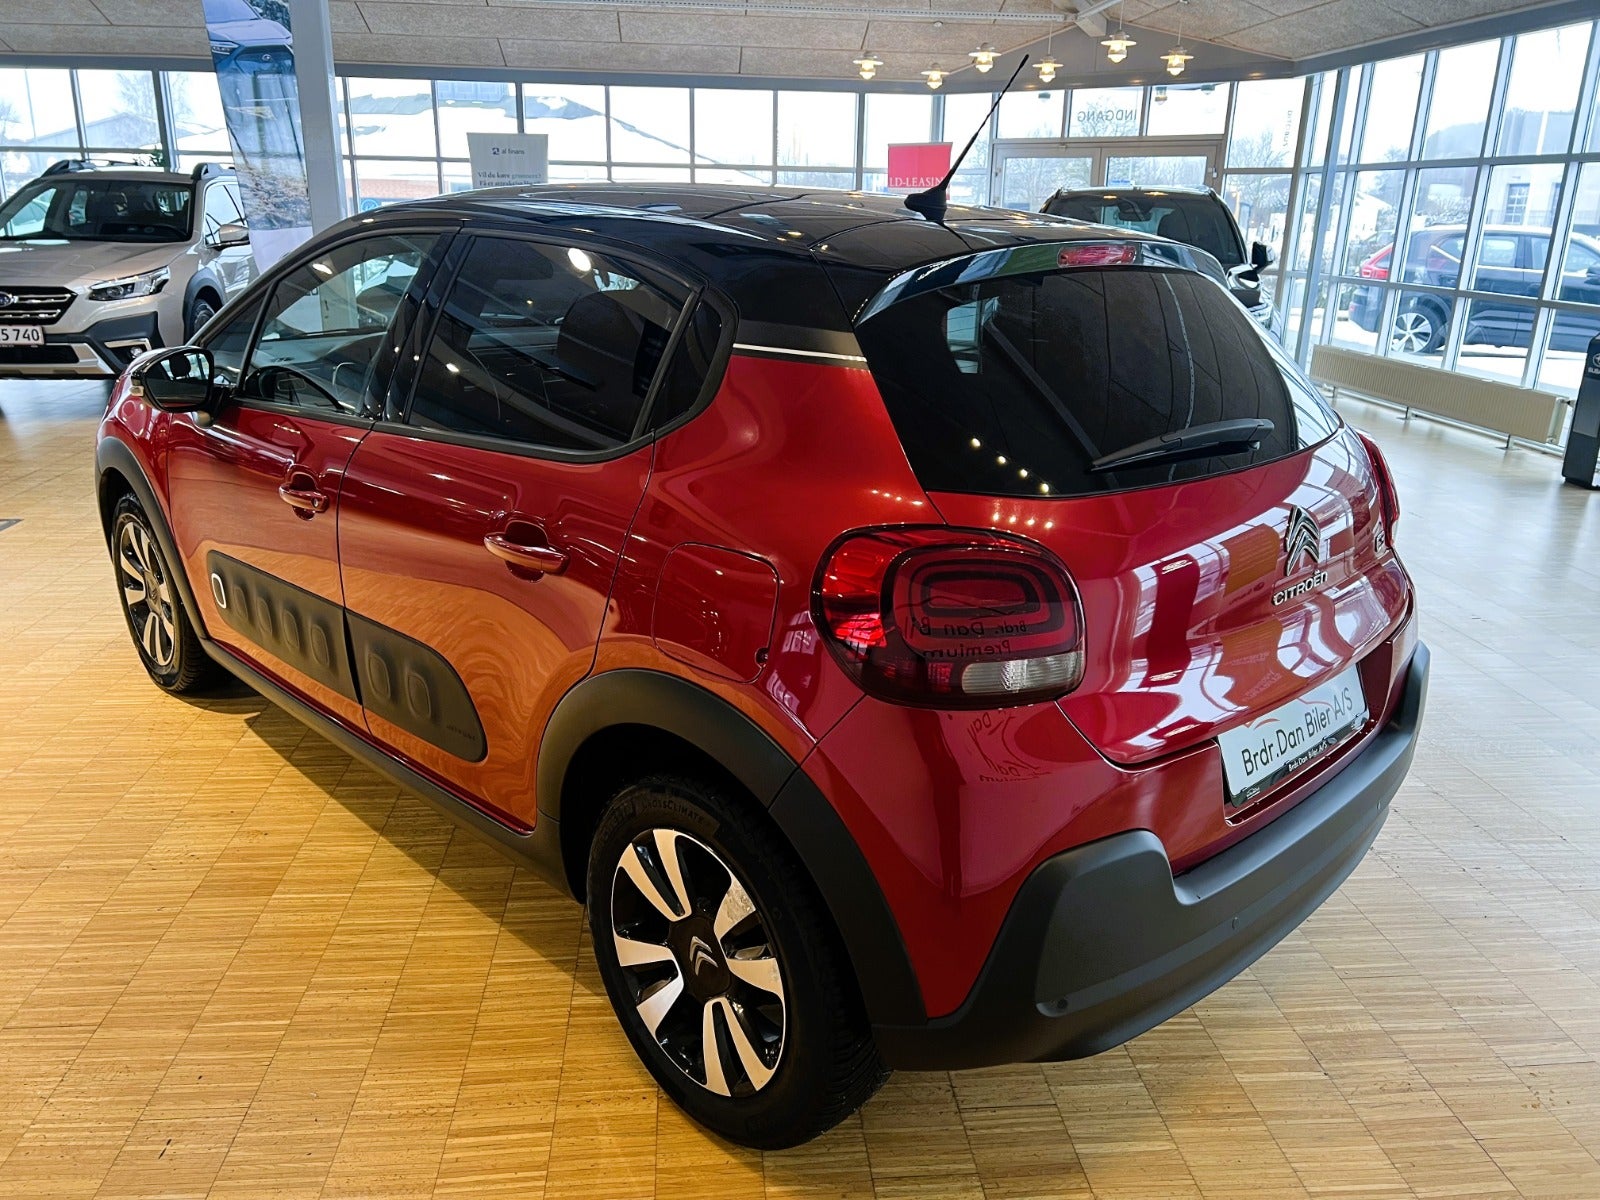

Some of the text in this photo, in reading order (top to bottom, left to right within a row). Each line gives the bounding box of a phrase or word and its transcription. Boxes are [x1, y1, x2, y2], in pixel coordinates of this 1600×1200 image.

[889, 176, 945, 187] LD-LEASIN
[1304, 706, 1331, 738] Biler
[1333, 687, 1353, 720] A/S
